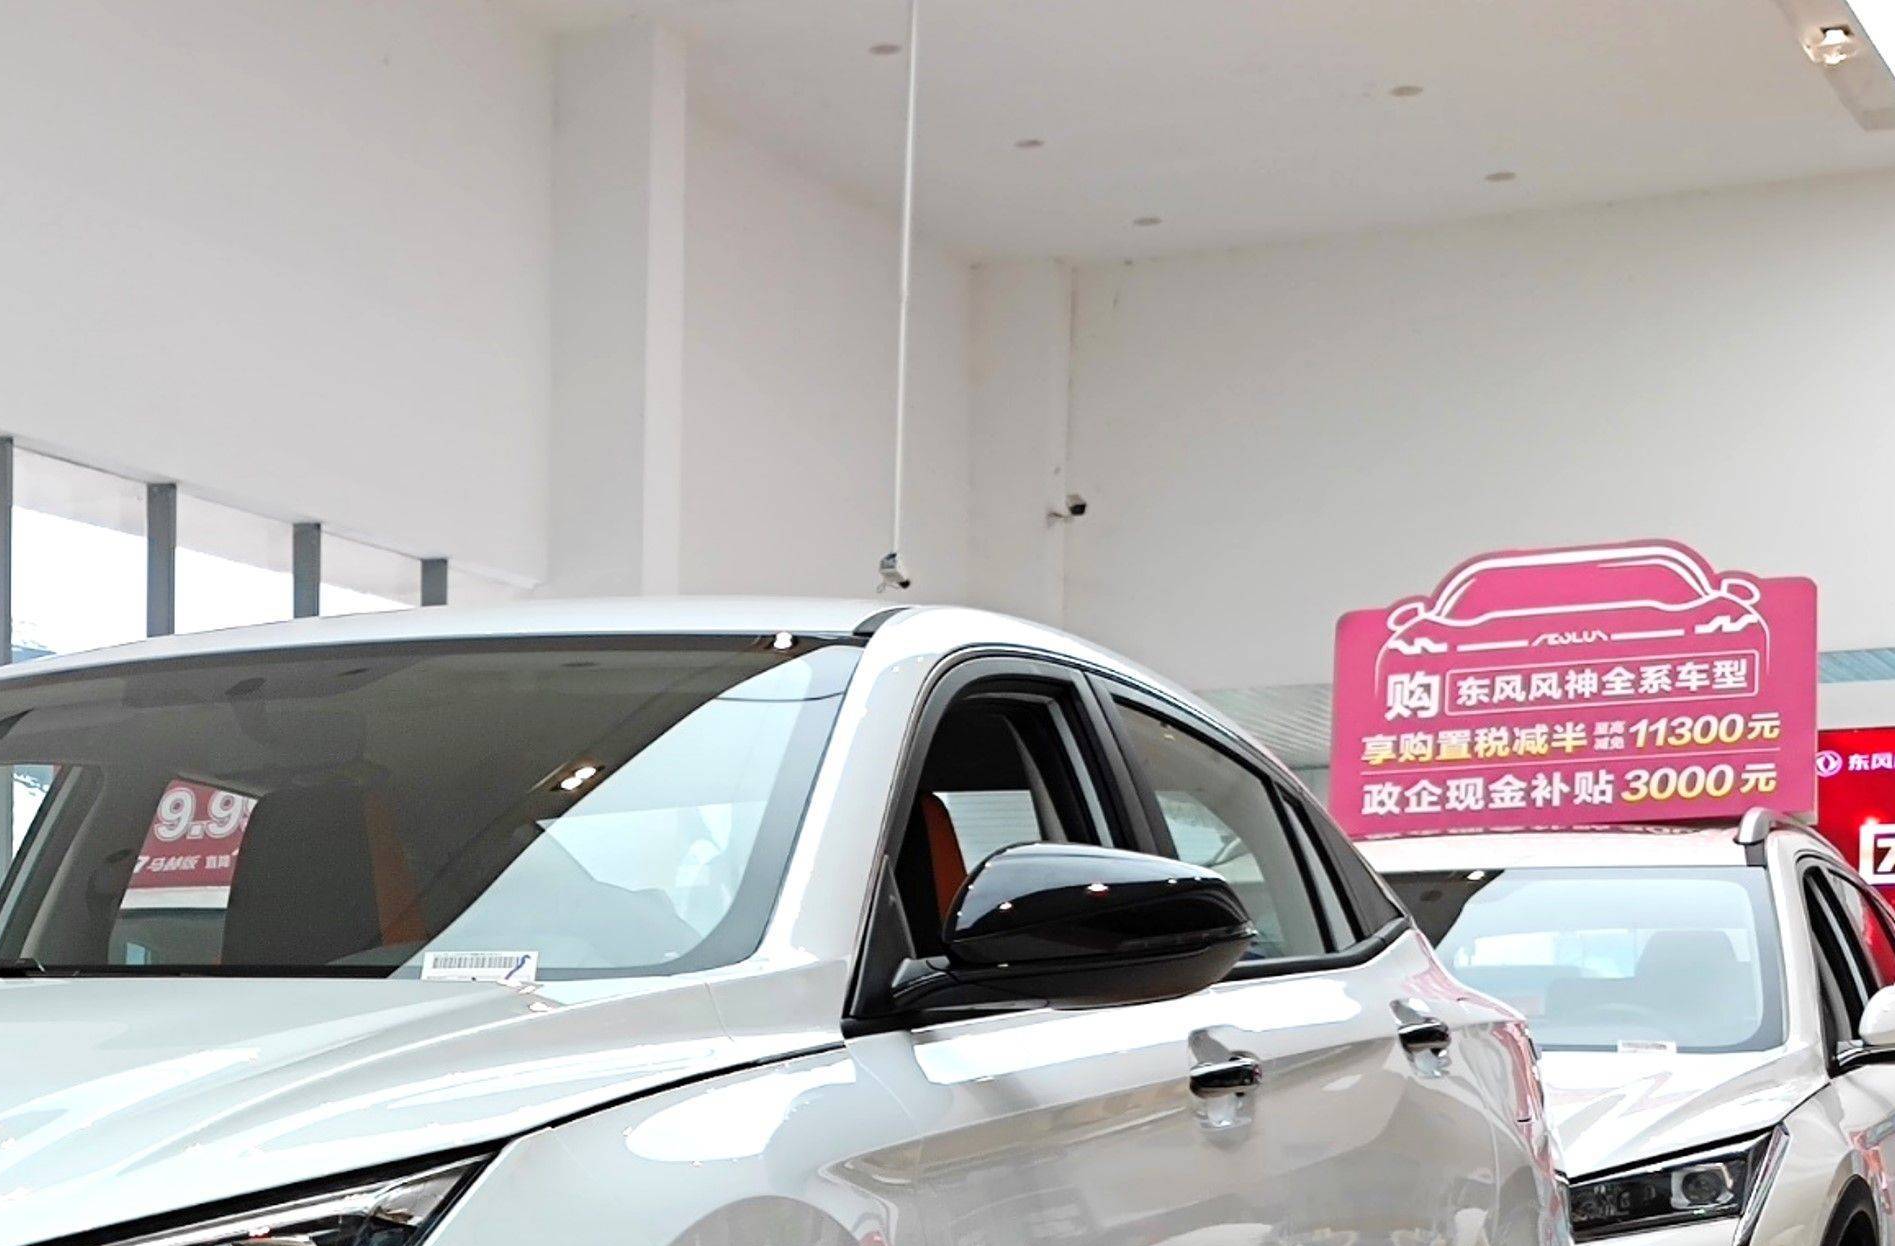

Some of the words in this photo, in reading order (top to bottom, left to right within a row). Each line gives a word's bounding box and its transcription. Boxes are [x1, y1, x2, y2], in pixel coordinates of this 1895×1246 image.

[1384, 670, 1441, 721] 购
[1456, 658, 1748, 706] 东风风神全系车型
[1360, 721, 1588, 765] 享购置税减半
[1848, 752, 1895, 771] 东风
